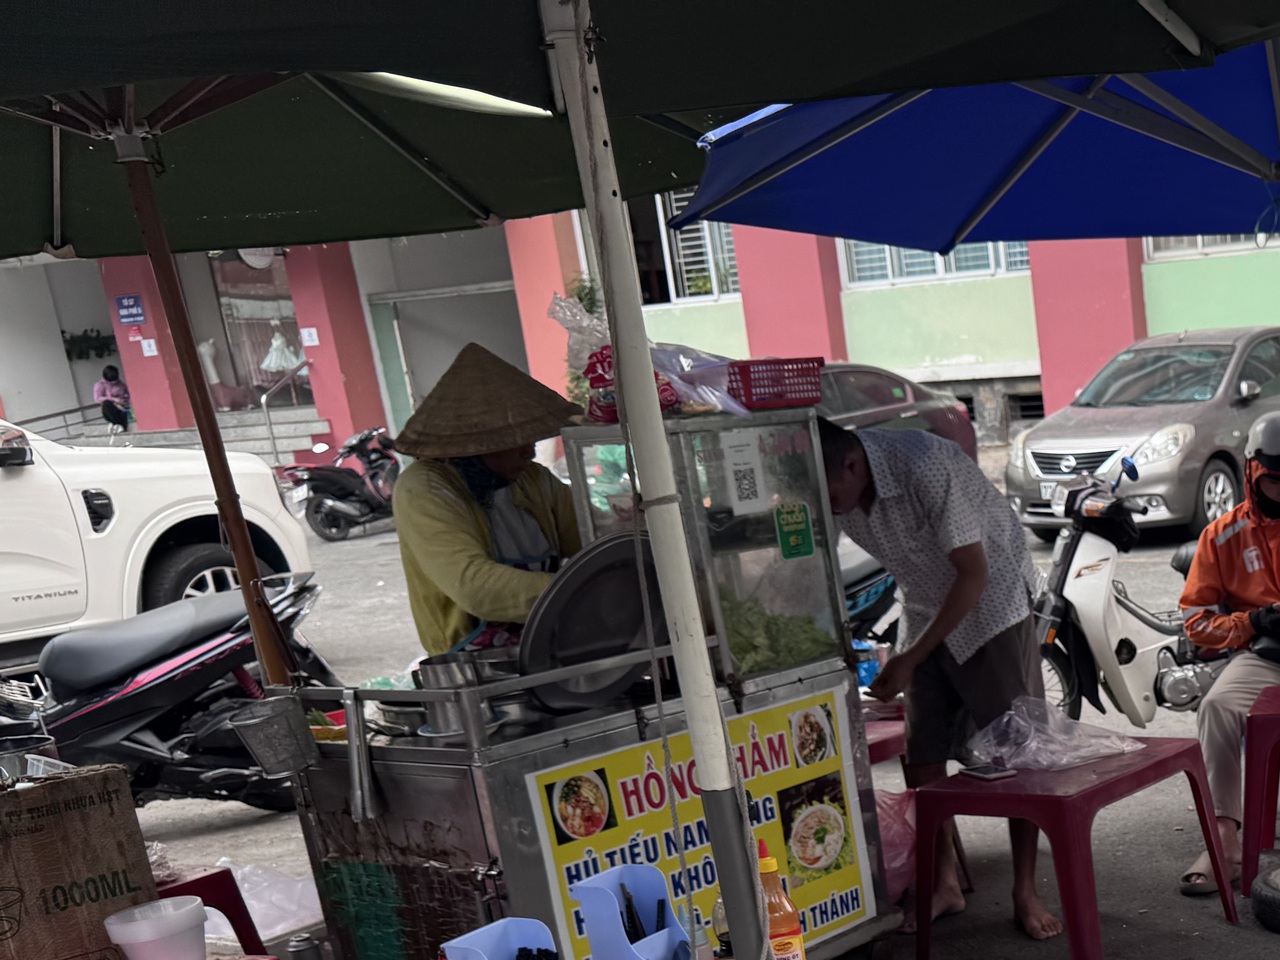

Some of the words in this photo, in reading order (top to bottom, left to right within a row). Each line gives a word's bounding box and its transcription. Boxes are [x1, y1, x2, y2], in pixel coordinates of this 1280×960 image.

[11, 589, 79, 602] TITANIUM
[38, 868, 142, 916] 1000ML
[809, 888, 861, 929] THÁNH
